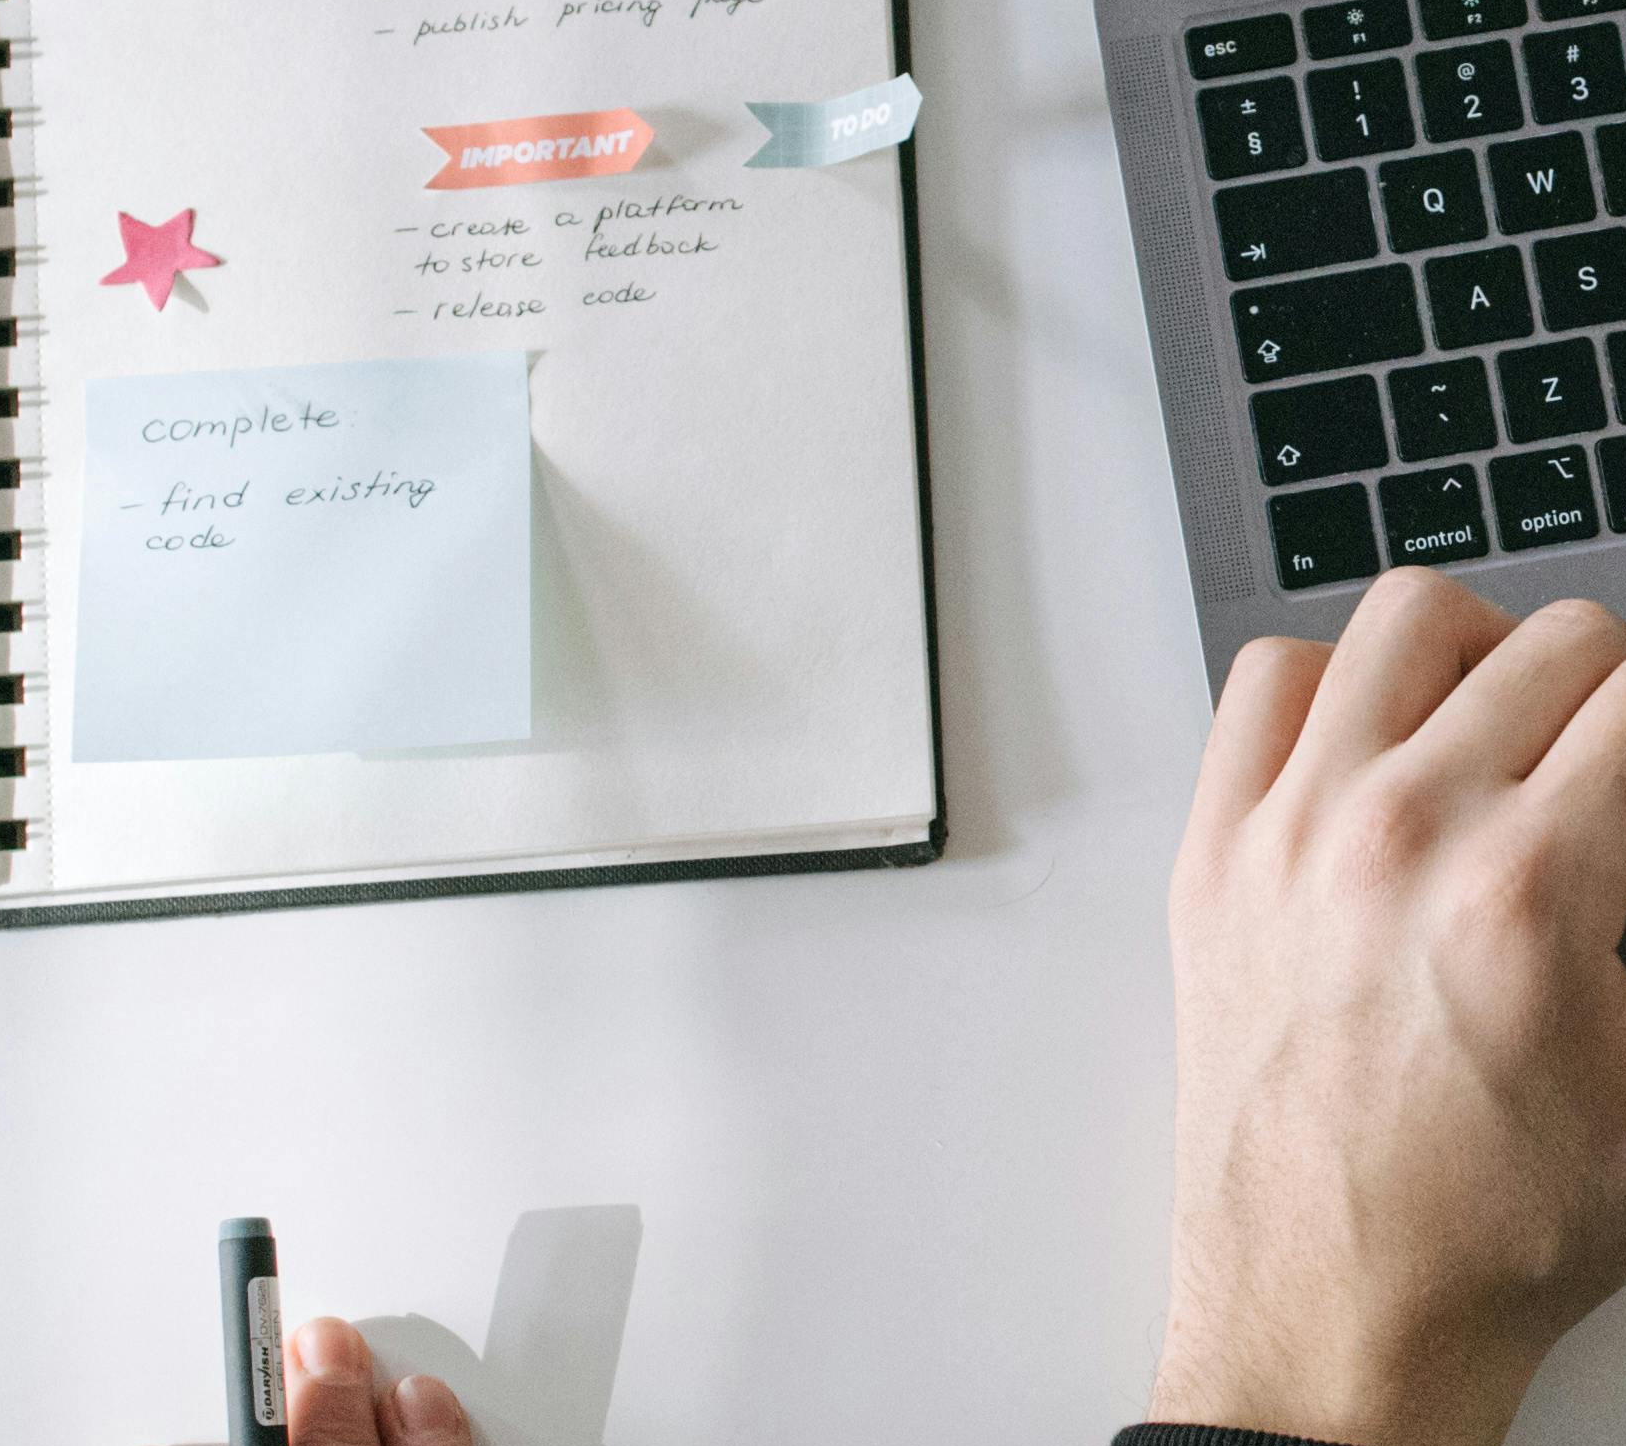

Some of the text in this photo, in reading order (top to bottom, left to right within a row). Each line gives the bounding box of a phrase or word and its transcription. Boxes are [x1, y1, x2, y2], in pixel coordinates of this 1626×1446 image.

[413, 9, 530, 46] publish
[1204, 39, 1237, 58] esc
[830, 103, 891, 141] TO DO
[460, 130, 634, 171] IMPORTANT
[430, 195, 744, 240] create a platform
[415, 231, 720, 276] to store feedback
[433, 283, 658, 322] release code
[160, 471, 437, 516] find existing
[146, 524, 238, 551] code
[1404, 525, 1473, 553] control
[1520, 507, 1583, 534] option
[1292, 552, 1314, 571] fn
